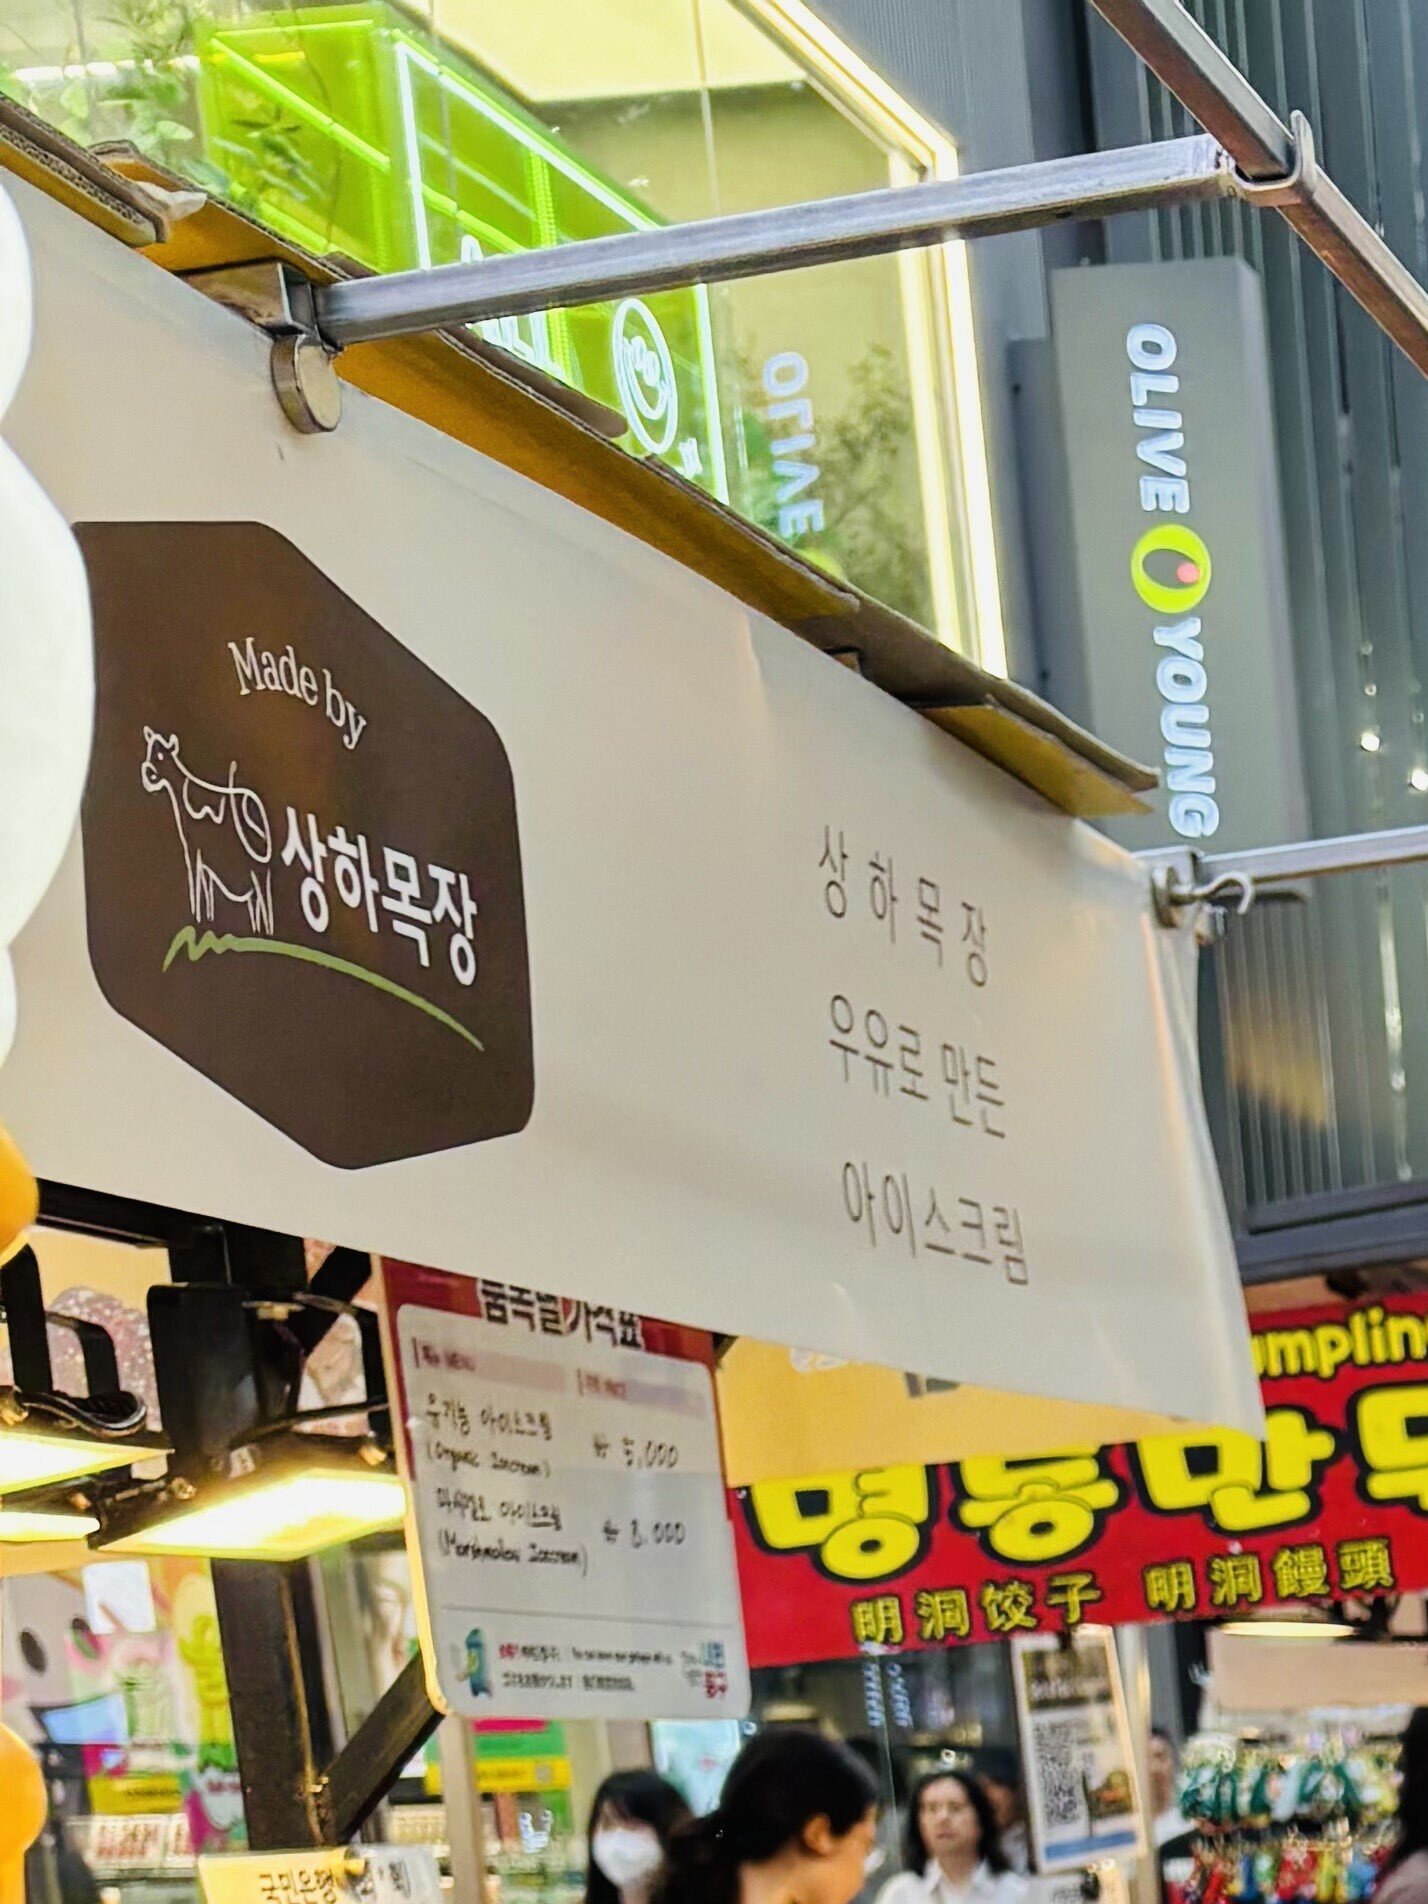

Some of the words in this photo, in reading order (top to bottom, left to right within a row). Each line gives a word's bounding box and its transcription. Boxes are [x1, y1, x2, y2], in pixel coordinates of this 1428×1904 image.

[1124, 322, 1191, 515] OLIVE
[228, 637, 319, 708] Made
[321, 669, 367, 750] by
[1152, 616, 1220, 838] YOUNG
[281, 806, 479, 987] 상하목장
[829, 994, 929, 1101] 우유로
[941, 1043, 1006, 1140] 만든
[842, 1161, 1029, 1286] 아이스크림
[852, 1573, 1103, 1646] 明洞饺子
